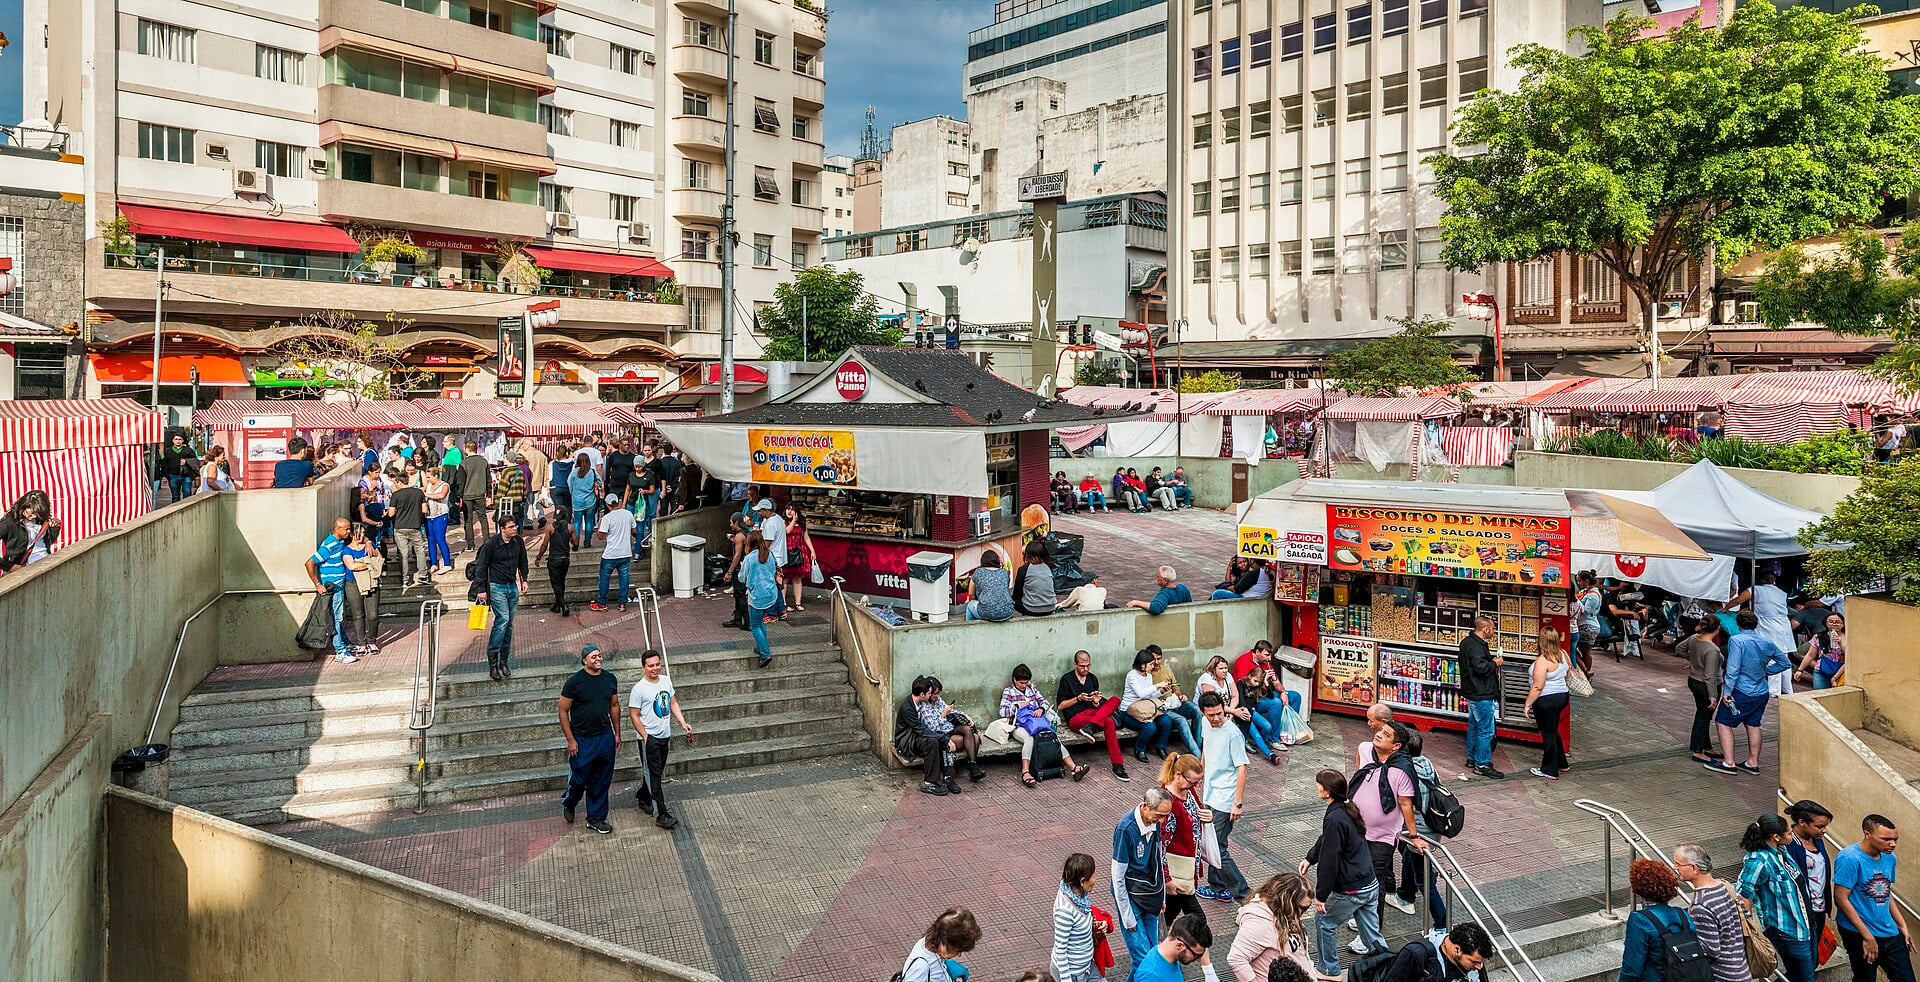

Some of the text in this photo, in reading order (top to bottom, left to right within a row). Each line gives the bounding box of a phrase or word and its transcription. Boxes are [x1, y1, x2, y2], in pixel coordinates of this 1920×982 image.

[426, 240, 473, 250] asian kitchen
[837, 371, 865, 382] Vitta
[1287, 370, 1309, 379] Kim
[837, 382, 865, 391] Panne
[763, 434, 834, 450] PROMOÇÃO!
[754, 453, 812, 464] 10 Mini Pães
[770, 463, 812, 475] de Queijo
[814, 469, 835, 481] 1,00
[1336, 507, 1560, 532] BISCOITO DE MINAS
[1242, 531, 1261, 539] TEMOS
[1287, 533, 1323, 543] TAPIOCA
[1381, 525, 1512, 540] DOCES & SALGADOS
[1523, 531, 1566, 540] Salgadinhos
[1290, 542, 1314, 551] DOCE
[1286, 549, 1323, 560] SALGADA
[1426, 556, 1462, 564] Bebidas
[875, 574, 908, 590] Vitta
[1324, 639, 1372, 649] PROMOÇÃO
[1327, 648, 1368, 662] MEL
